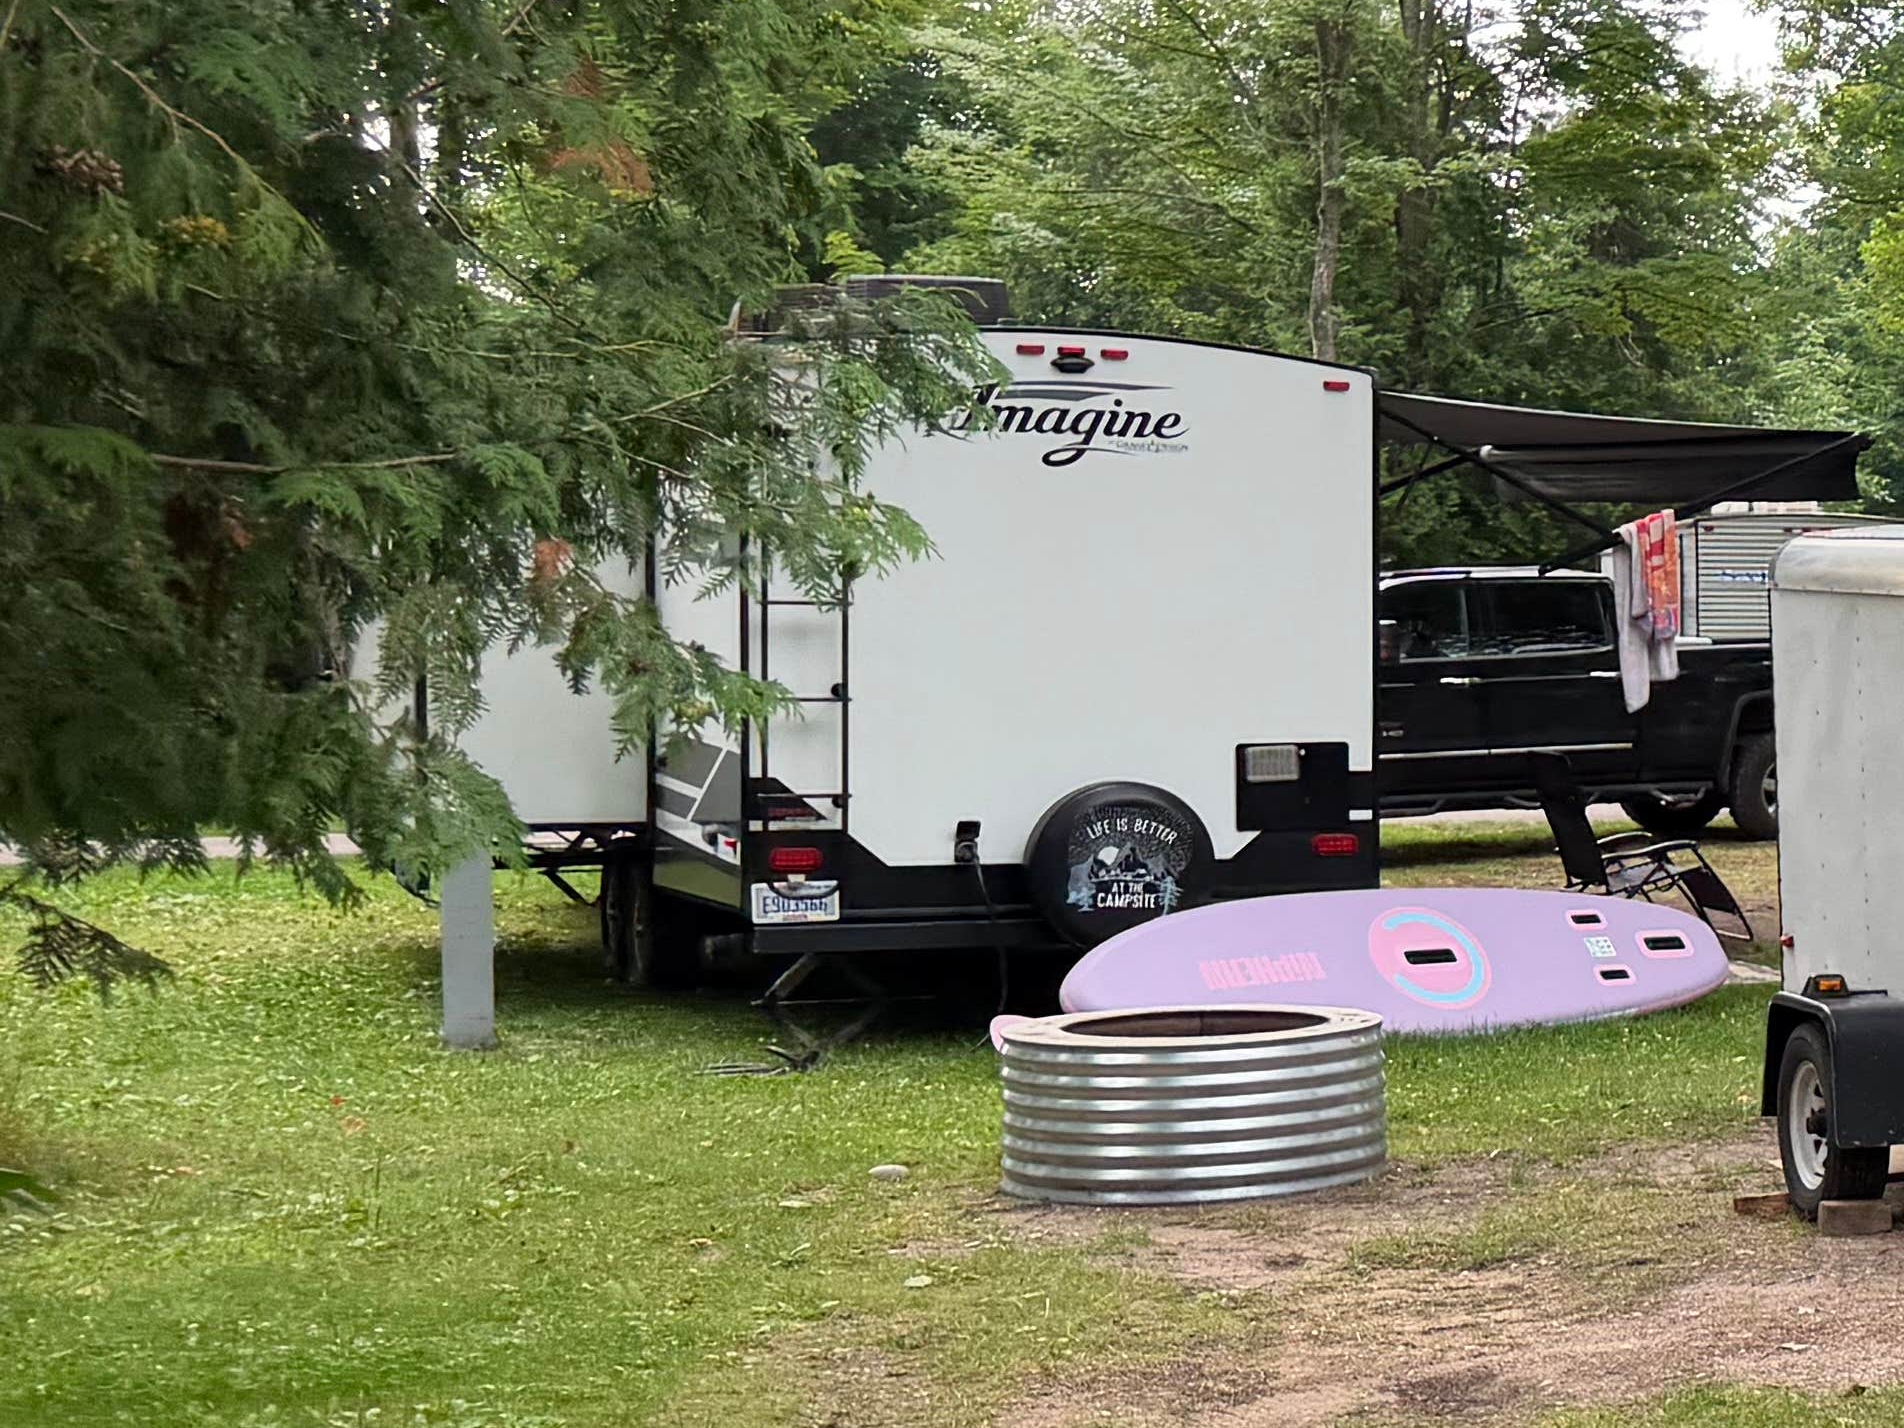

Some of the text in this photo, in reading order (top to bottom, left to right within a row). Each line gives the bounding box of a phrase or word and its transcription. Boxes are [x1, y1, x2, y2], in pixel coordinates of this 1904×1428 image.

[1086, 817, 1178, 845] LIFE IS BETTER
[1111, 882, 1144, 893] AT THE
[1096, 892, 1156, 909] CAMPSITE
